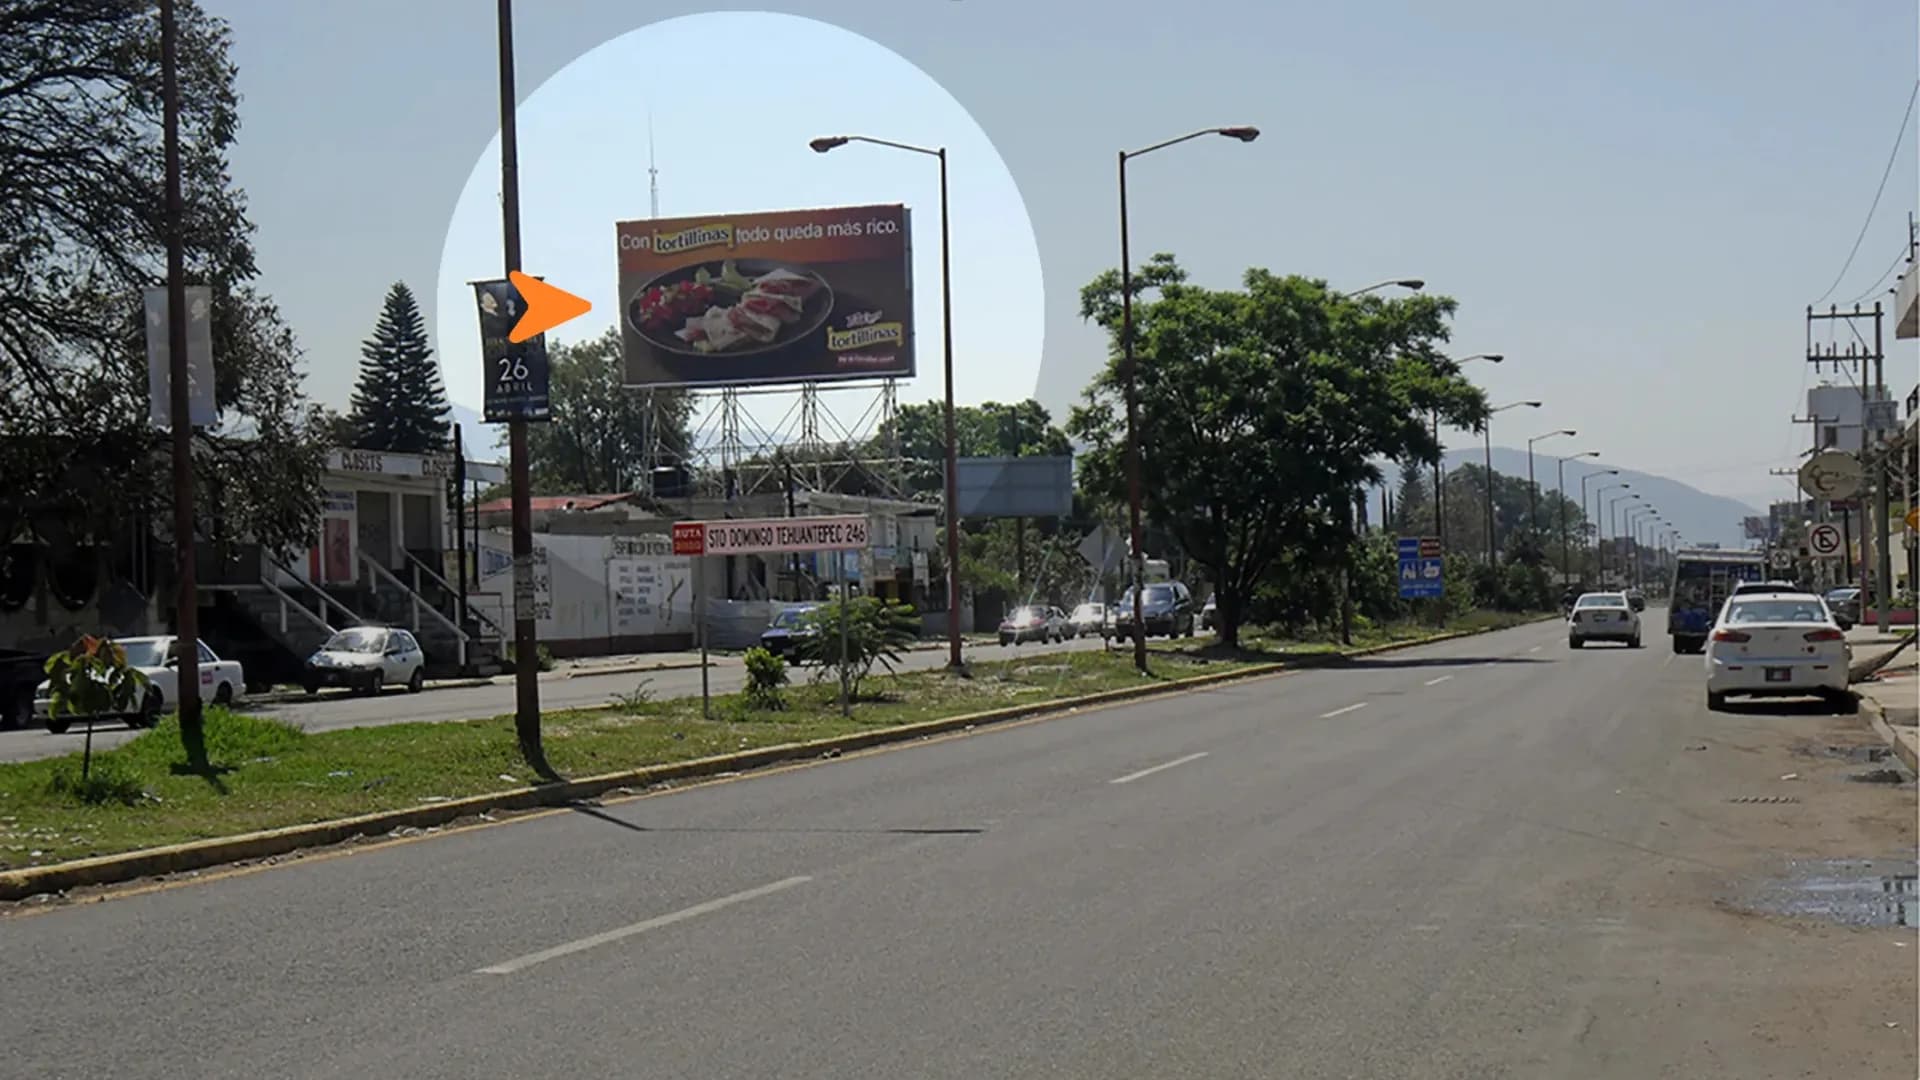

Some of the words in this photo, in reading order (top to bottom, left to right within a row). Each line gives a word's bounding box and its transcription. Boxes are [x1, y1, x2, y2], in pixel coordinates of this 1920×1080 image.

[620, 233, 650, 250] Con
[656, 227, 729, 251] tortillinas
[736, 226, 769, 244] todo
[774, 223, 823, 243] queda
[827, 218, 862, 236] más
[866, 216, 899, 234] rico.
[832, 327, 898, 348] tortillinas
[499, 358, 529, 381] 26
[496, 382, 533, 393] ABRIL
[342, 452, 383, 472] CLOSETS
[674, 528, 702, 538] RUTA
[708, 528, 726, 548] STO
[730, 526, 773, 547] DOMINGO
[776, 524, 843, 545] TEHUANTEPEC
[846, 522, 866, 544] 246
